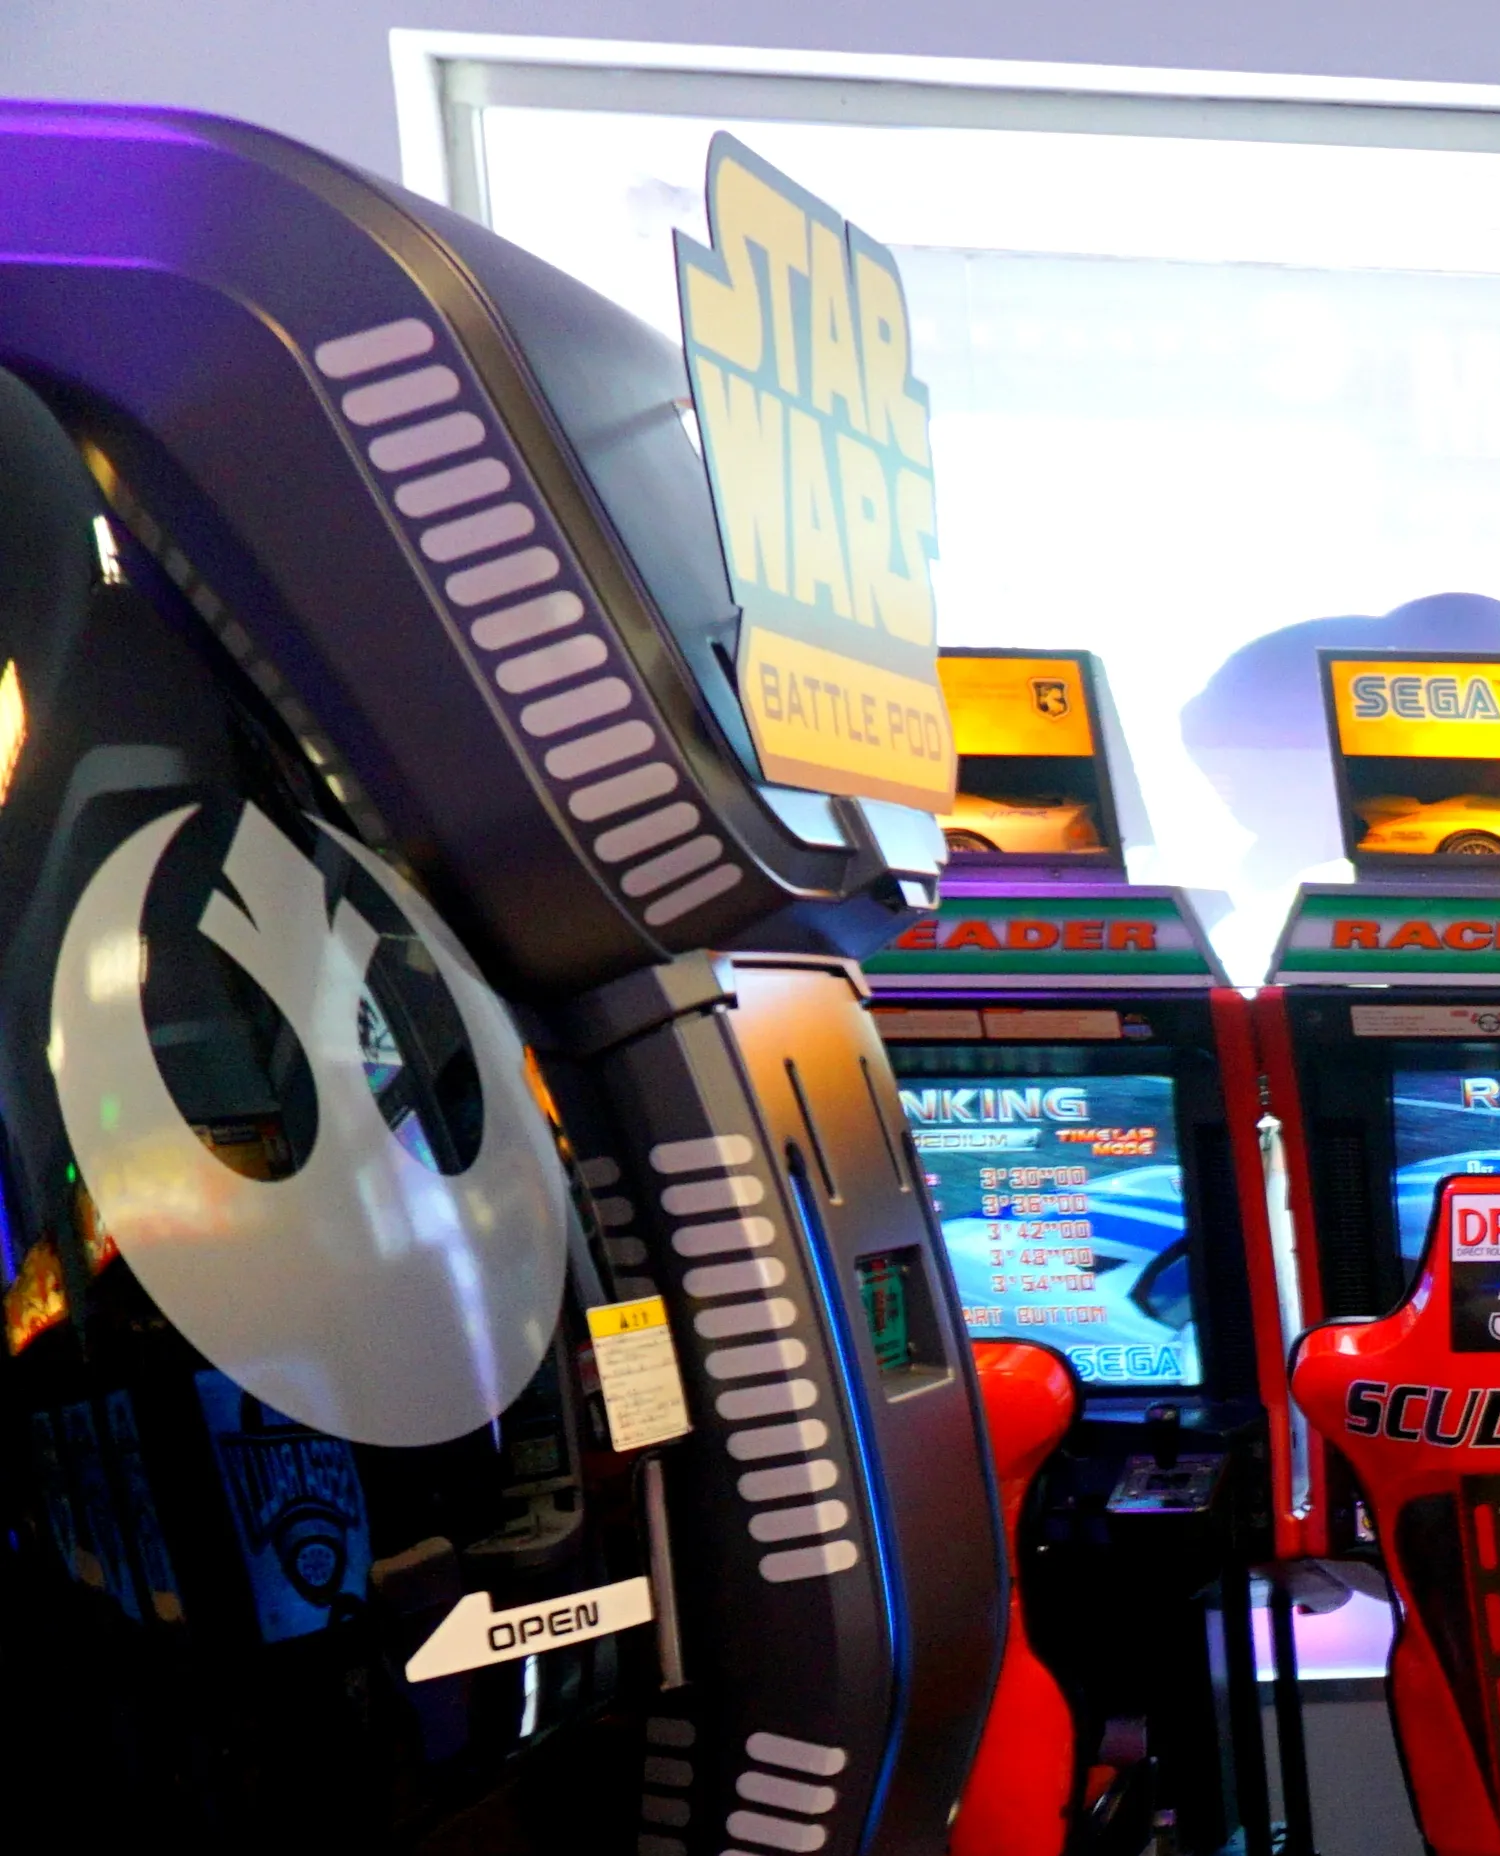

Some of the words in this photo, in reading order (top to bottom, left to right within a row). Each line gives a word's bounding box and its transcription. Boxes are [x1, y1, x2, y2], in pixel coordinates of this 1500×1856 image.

[686, 157, 928, 467] STAR
[696, 355, 935, 645] WARS
[759, 663, 879, 745] BATTLE
[889, 701, 942, 761] POD
[1092, 1142, 1156, 1156] MODE
[1456, 1247, 1485, 1257] DIRECT
[1066, 1345, 1182, 1381] SEGA
[487, 1599, 600, 1652] OPEN
